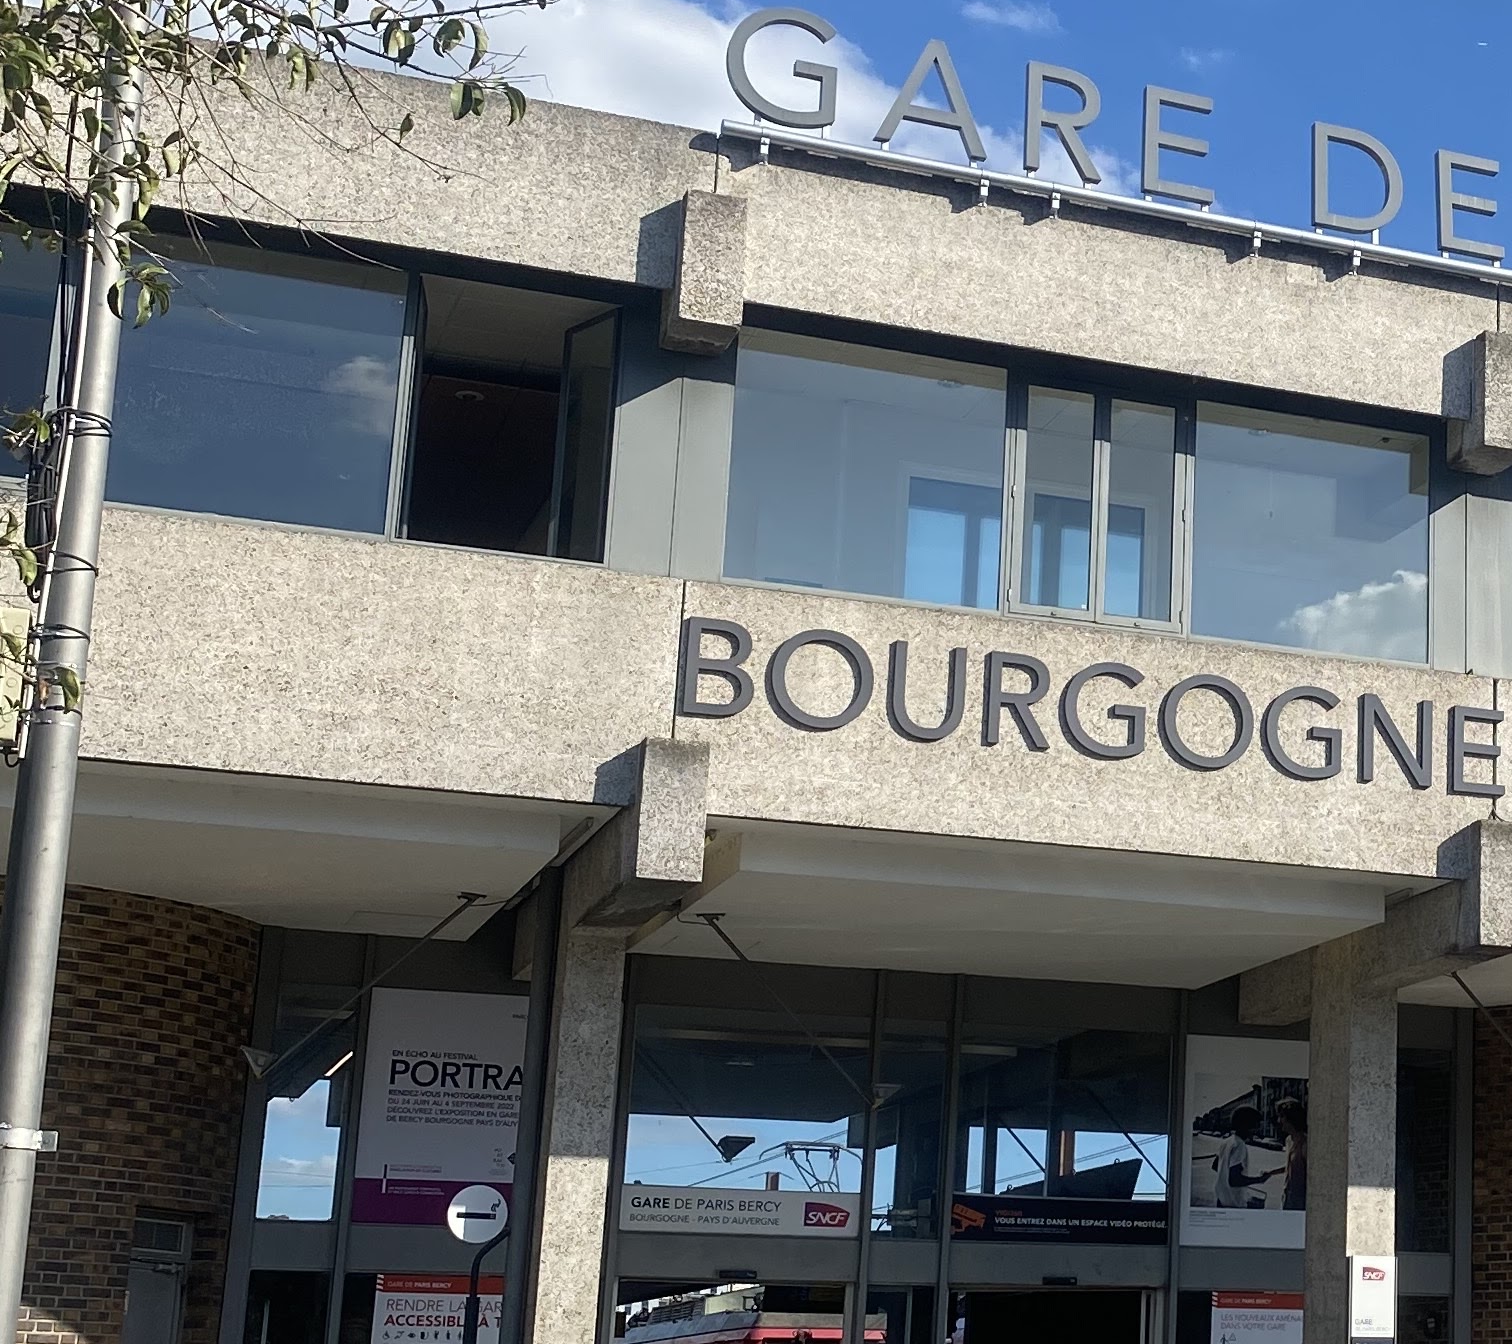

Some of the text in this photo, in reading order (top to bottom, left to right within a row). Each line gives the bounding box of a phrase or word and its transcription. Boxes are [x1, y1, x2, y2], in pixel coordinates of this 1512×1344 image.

[726, 7, 1215, 204] GARE
[1311, 121, 1505, 260] DE
[680, 615, 1506, 797] BOURGOGNE
[443, 1052, 478, 1061] FESTIVAL
[389, 1058, 523, 1091] PORTRA
[443, 1091, 513, 1102] PHOTOGRAPHIQUE
[451, 1100, 495, 1109] SEPTEMBRE
[631, 1196, 782, 1213] GARE DE PARIS BERCY
[629, 1213, 690, 1224] BOURGOGNE
[697, 1215, 721, 1225] PAYS
[722, 1215, 780, 1226] D'AUVERGNE
[805, 1211, 848, 1225] SNCF
[994, 1217, 1016, 1225] VOUS
[1016, 1217, 1045, 1226] ENTREZ
[1046, 1218, 1067, 1226] DANS
[1068, 1218, 1080, 1226] UN
[1081, 1219, 1108, 1227] ESPACE
[1109, 1218, 1132, 1228] VIDÉO
[1362, 1271, 1385, 1280] SNCF
[414, 1281, 431, 1289] PARIS
[386, 1298, 444, 1312] RENDRE
[449, 1300, 466, 1313] LA
